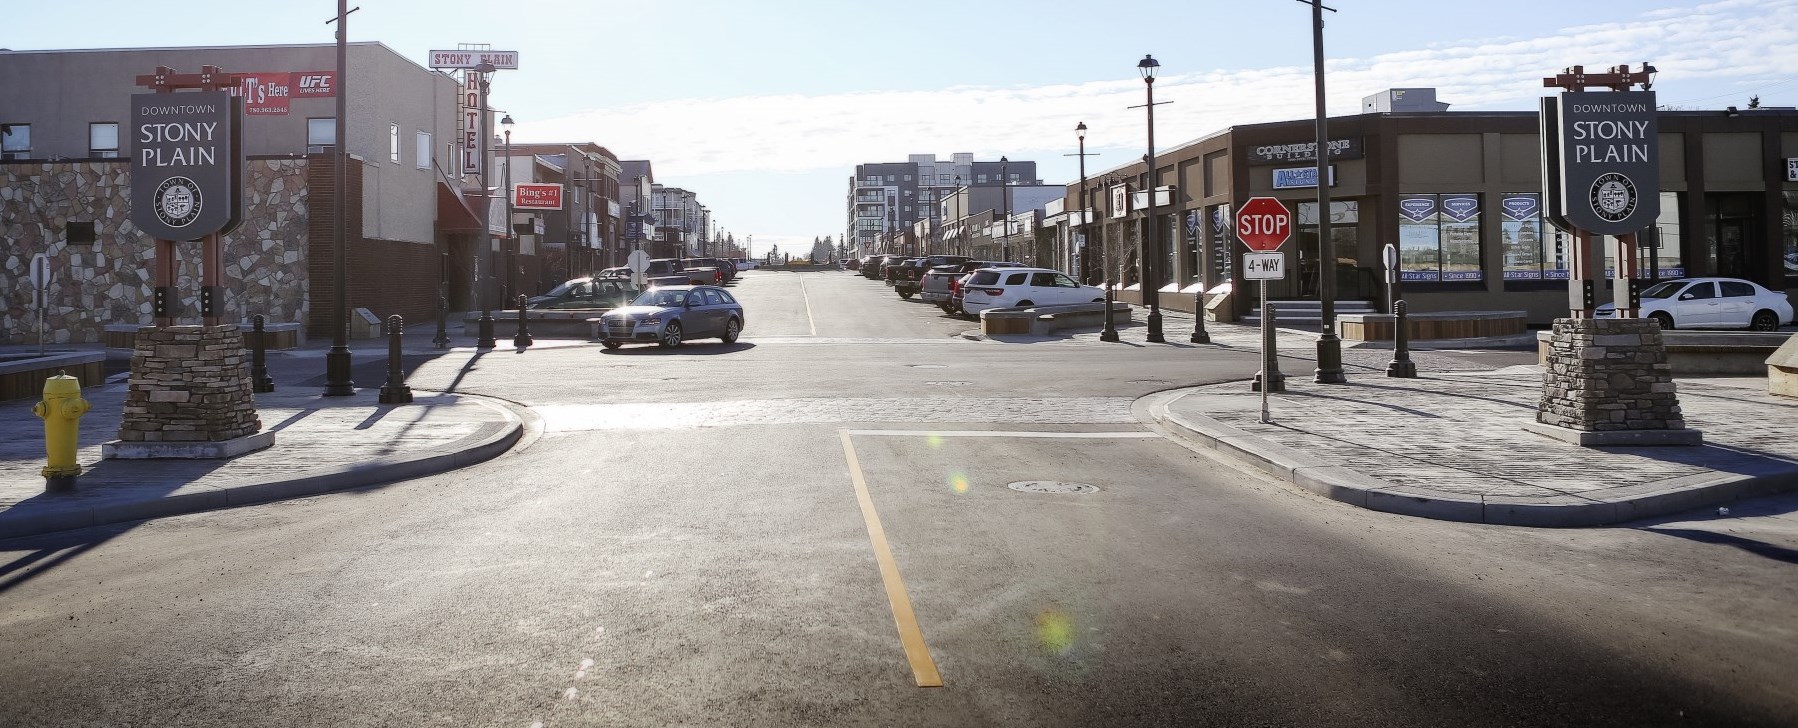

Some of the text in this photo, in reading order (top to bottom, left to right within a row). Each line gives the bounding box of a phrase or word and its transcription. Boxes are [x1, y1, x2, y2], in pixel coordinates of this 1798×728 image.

[434, 54, 513, 65] STONY PLAIN
[300, 75, 333, 88] UFC
[268, 82, 289, 97] Here
[141, 104, 216, 116] DOWNTOWN
[1573, 104, 1647, 113] DOWNTOWN
[466, 72, 478, 169] HOTEL
[140, 122, 218, 143] STONY
[1573, 120, 1649, 139] STONY
[142, 146, 216, 167] PLAIN
[1575, 144, 1648, 163] PLAIN
[159, 178, 184, 193] TOWN
[1594, 174, 1619, 188] TOWN
[520, 187, 558, 199] Bing's #1
[155, 201, 201, 225] STONY PLAIN
[1591, 196, 1636, 219] STONY PLAIN
[1240, 214, 1288, 235] STOP
[1248, 258, 1280, 272] 4-WAY
[1523, 271, 1539, 279] Signs
